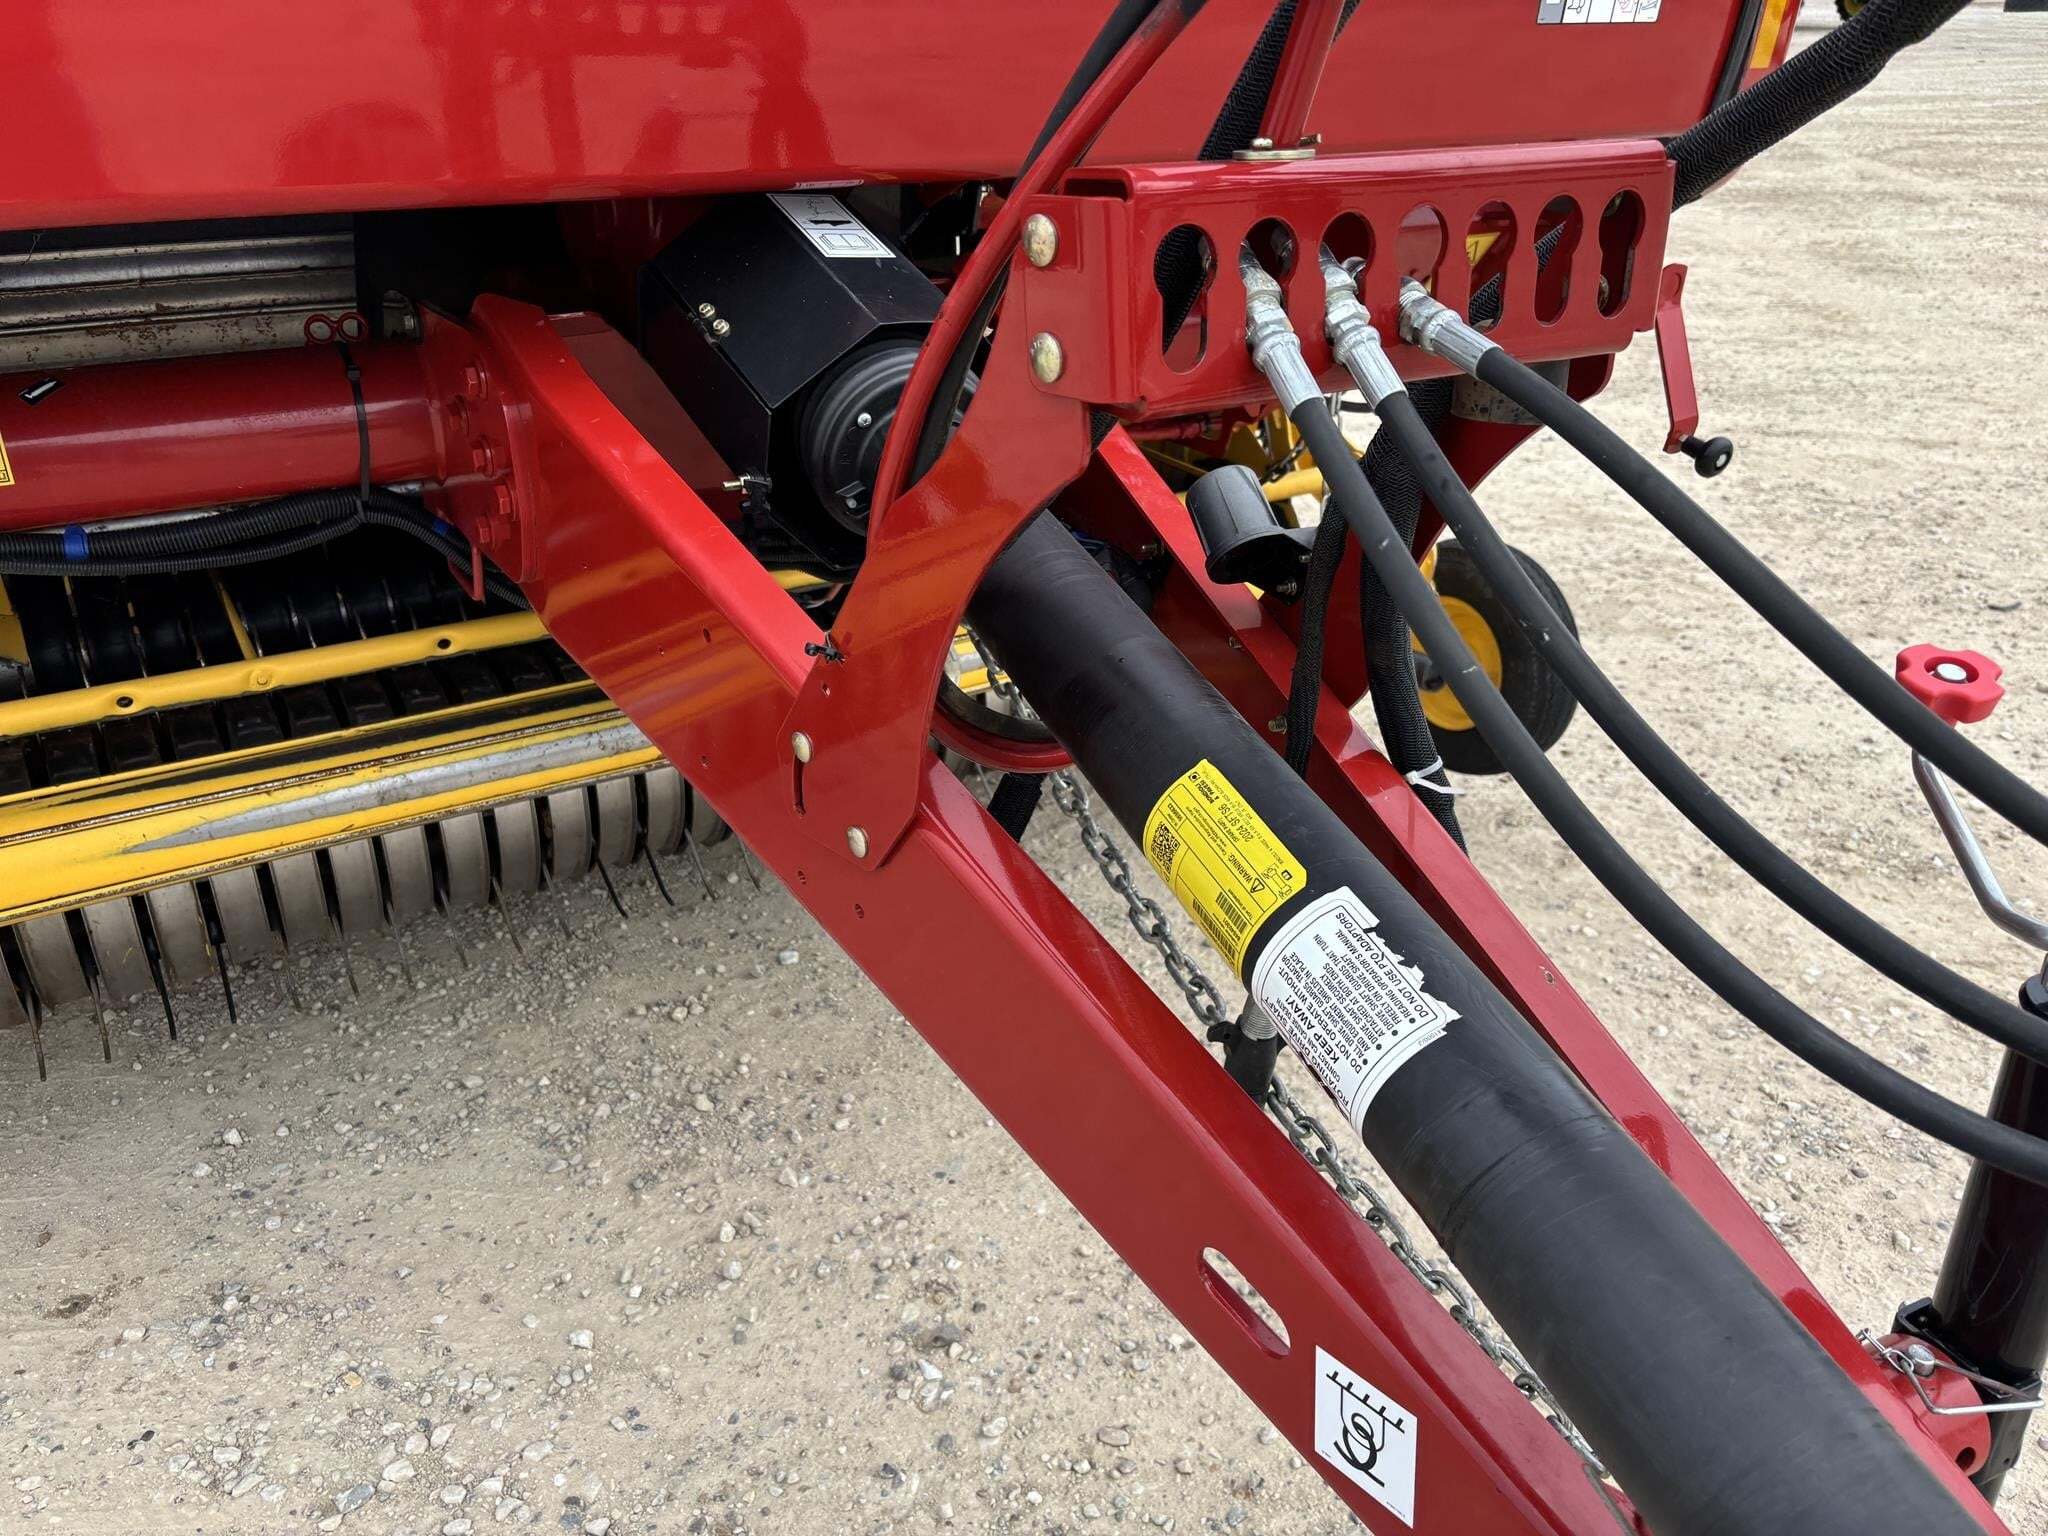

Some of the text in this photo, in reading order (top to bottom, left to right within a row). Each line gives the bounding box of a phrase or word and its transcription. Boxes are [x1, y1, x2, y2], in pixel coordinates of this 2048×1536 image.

[1235, 823, 1254, 843] 2024
[1334, 910, 1375, 955] ADAPTORS
[1368, 950, 1388, 971] PTO
[1279, 953, 1305, 983] TRACTOR
[1311, 932, 1395, 1031] DRIVE SHAFT GUARDS THAT TURN
[1333, 928, 1412, 1019] READING OPERATOR'S MANUAL
[1339, 951, 1402, 1025] FREELY ON DRIVE SHAFT
[1382, 966, 1402, 988] USE
[1397, 983, 1417, 1006] NOT
[1275, 964, 1363, 1074] DO NOT OPERATE WITHOUT-
[1287, 950, 1371, 1052] AND EQUIPMENT SHIELDS IN PLACE
[1318, 972, 1379, 1045] DRIVE SHAFT SECURELY
[1320, 1005, 1341, 1028] SHAFT
[1321, 961, 1386, 1038] ATTACHED AT BOTH ENDS
[1412, 1001, 1429, 1019] DO
[1263, 995, 1350, 1106] ROTATING DRIVE SHAFT
[1274, 996, 1342, 1082] CONTACT CAN CAUSE DEATH
[1283, 994, 1341, 1064] KEEP AWAY!
[1335, 1024, 1356, 1047] DRIVE
[1350, 1043, 1365, 1059] ALL
